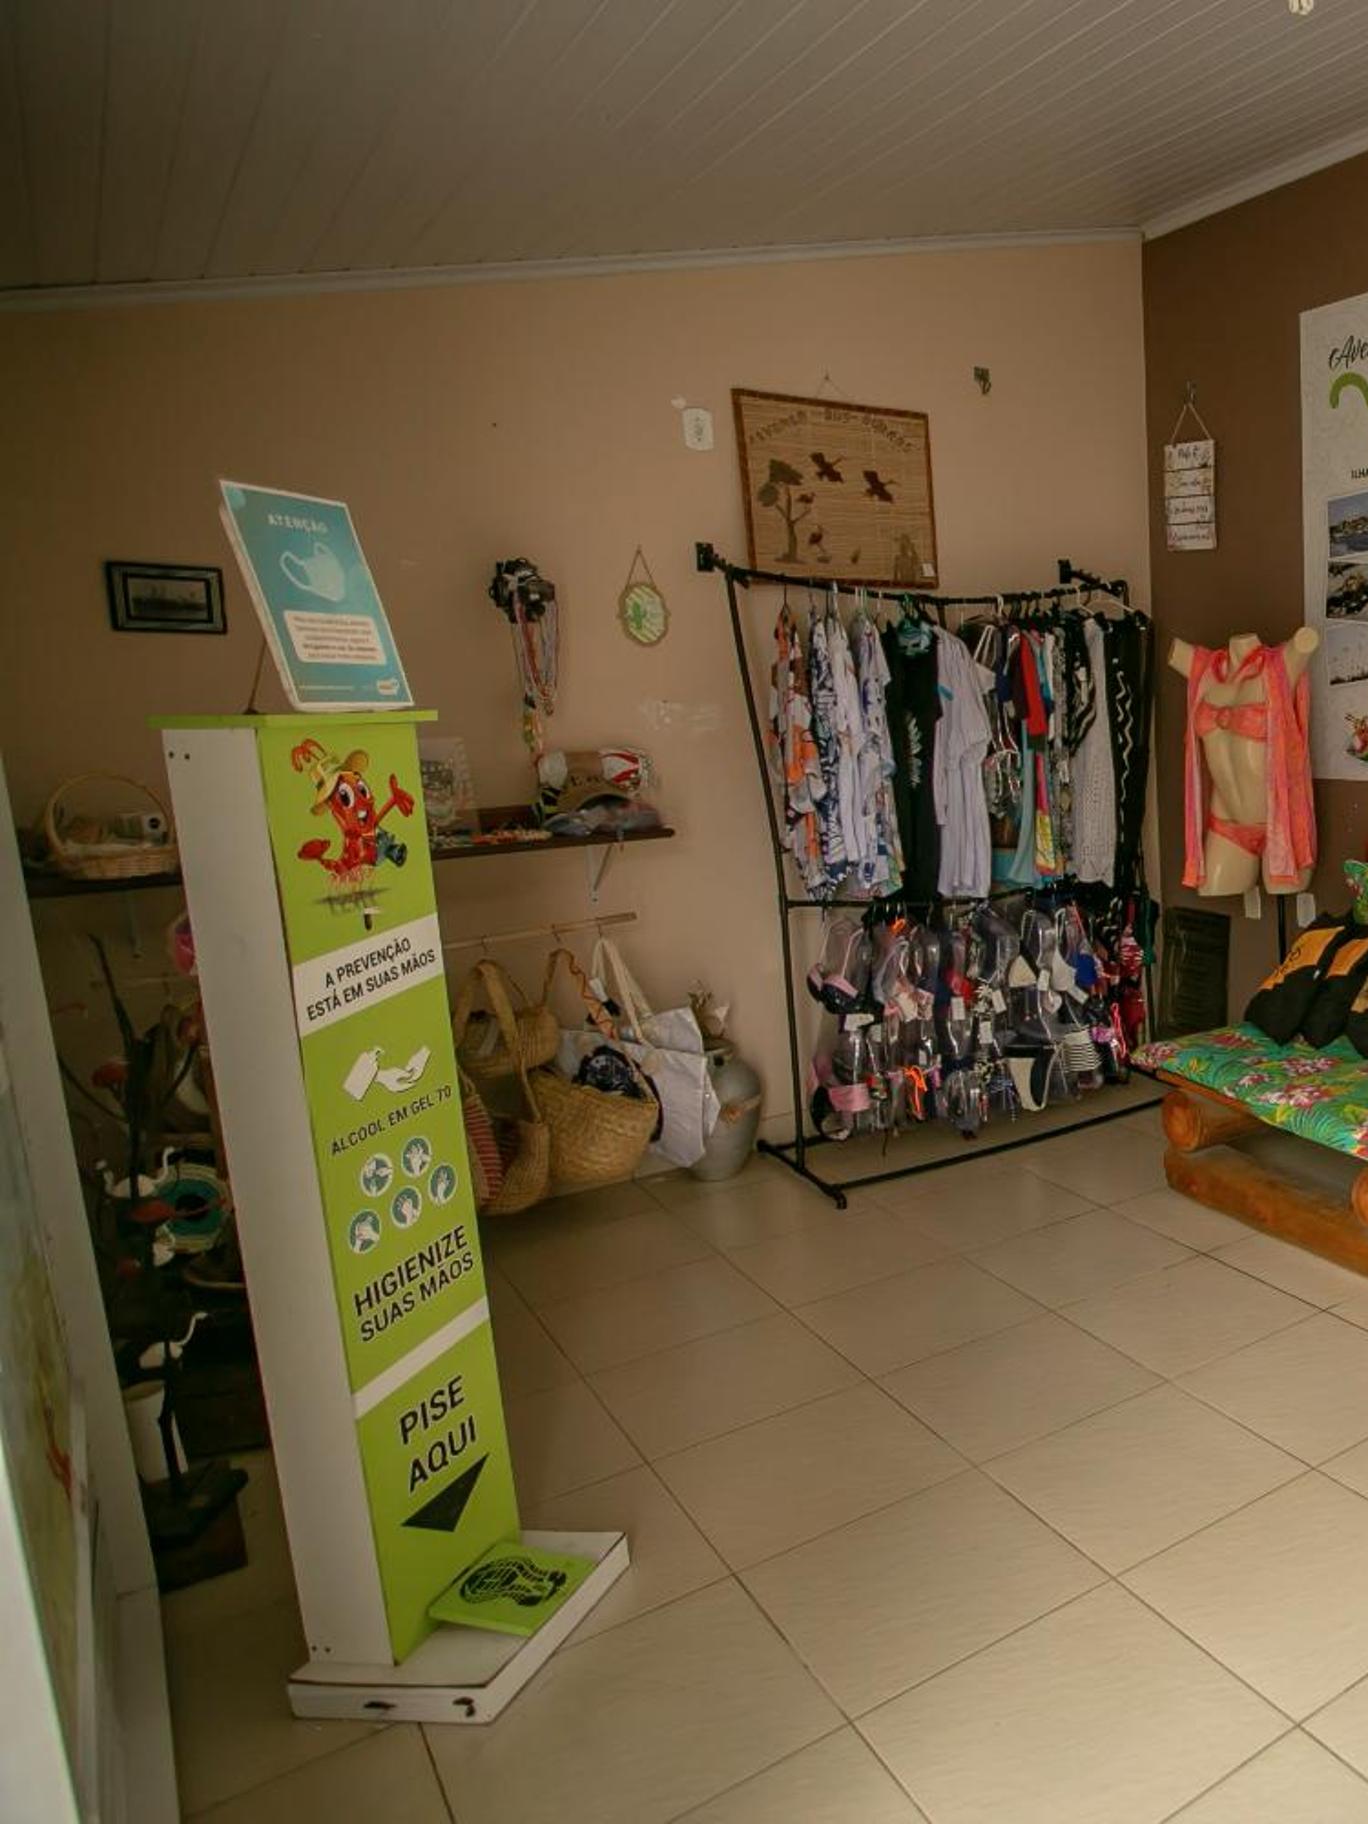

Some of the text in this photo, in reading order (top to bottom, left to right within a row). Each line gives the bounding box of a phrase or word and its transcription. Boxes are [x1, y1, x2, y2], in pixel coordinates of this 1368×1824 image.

[267, 512, 329, 534] ATENÇÃO
[306, 949, 437, 1021] ESTÁ EM SUAS MÃOS
[324, 936, 412, 989] A PREVENÇÃO
[331, 1118, 386, 1156] ALCOOL
[388, 1106, 409, 1128] EM
[411, 1092, 436, 1115] GEL
[353, 1225, 469, 1317] HIGIENIZE
[359, 1252, 474, 1342] SUAS MÃOS
[399, 1375, 465, 1446] PISE
[408, 1415, 478, 1493] AQUI
